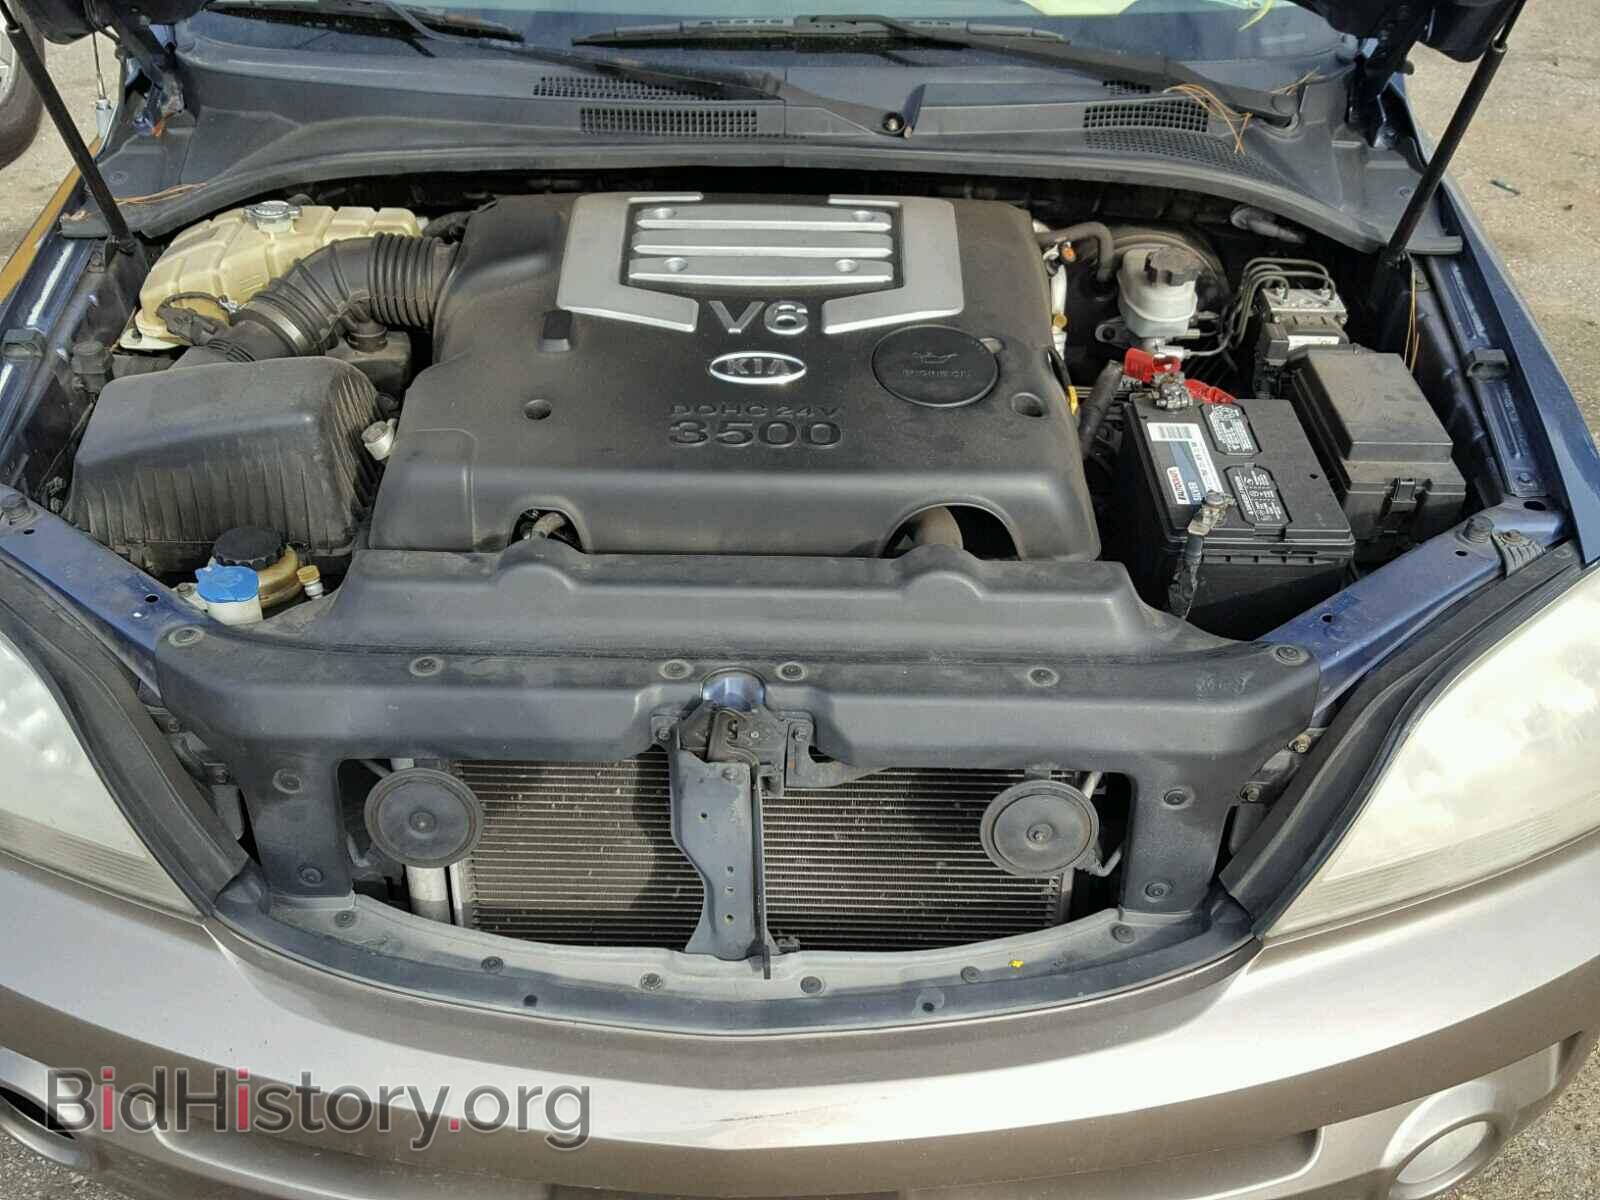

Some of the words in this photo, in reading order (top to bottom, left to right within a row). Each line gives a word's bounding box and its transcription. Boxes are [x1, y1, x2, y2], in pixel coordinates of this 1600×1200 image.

[708, 300, 809, 335] V6
[725, 357, 792, 377] KIA
[672, 404, 769, 418] DOHC
[775, 404, 842, 418] 24V
[668, 420, 842, 448] 3500
